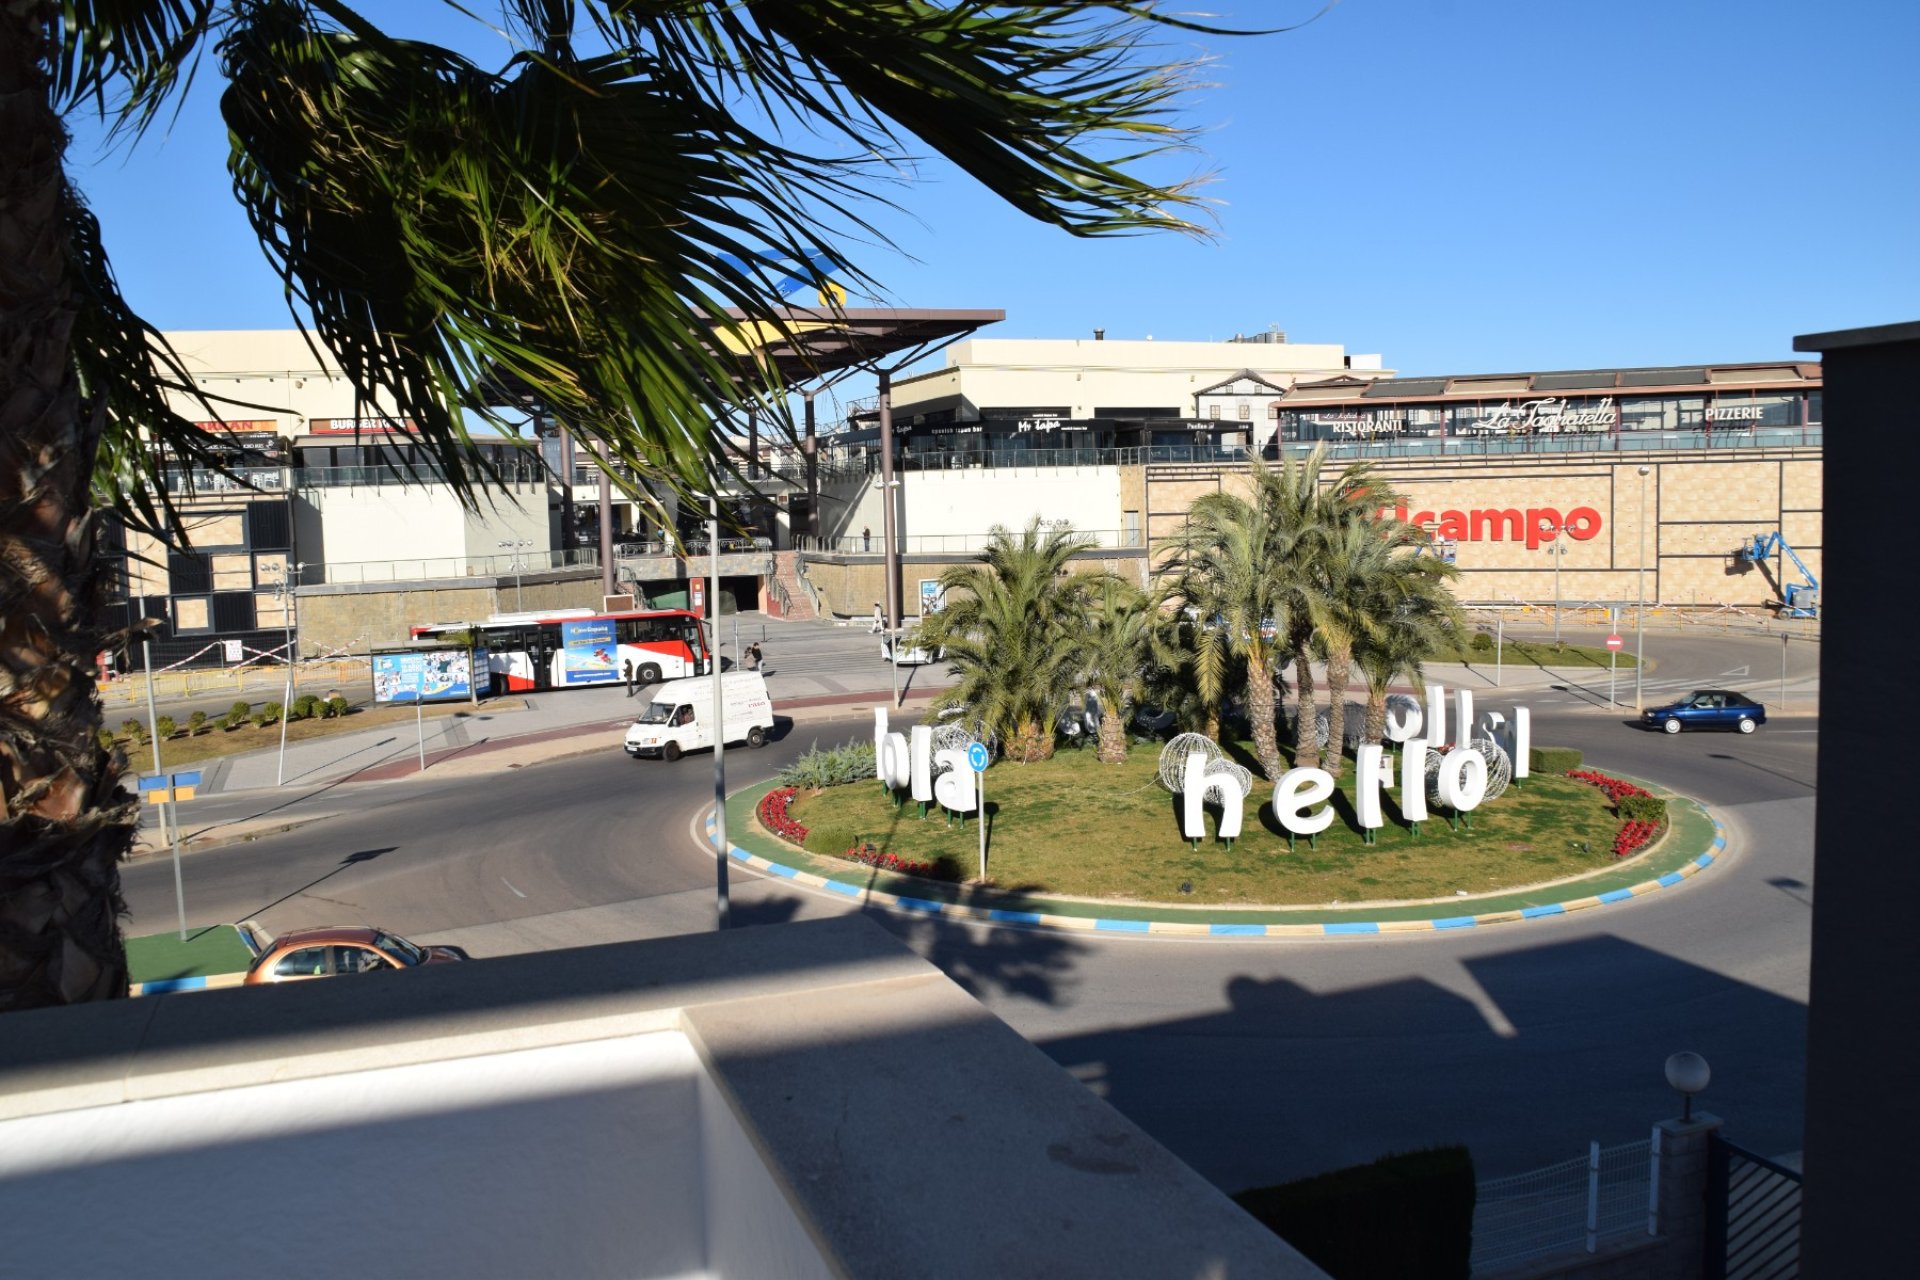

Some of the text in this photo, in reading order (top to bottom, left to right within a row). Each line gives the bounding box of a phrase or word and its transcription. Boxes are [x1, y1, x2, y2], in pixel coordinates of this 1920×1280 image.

[330, 418, 377, 430] BURER
[1472, 397, 1617, 431] La Tagliatella
[1705, 406, 1764, 421] PIZZERIE
[1371, 495, 1603, 551] lcampo
[1184, 737, 1488, 838] hello
